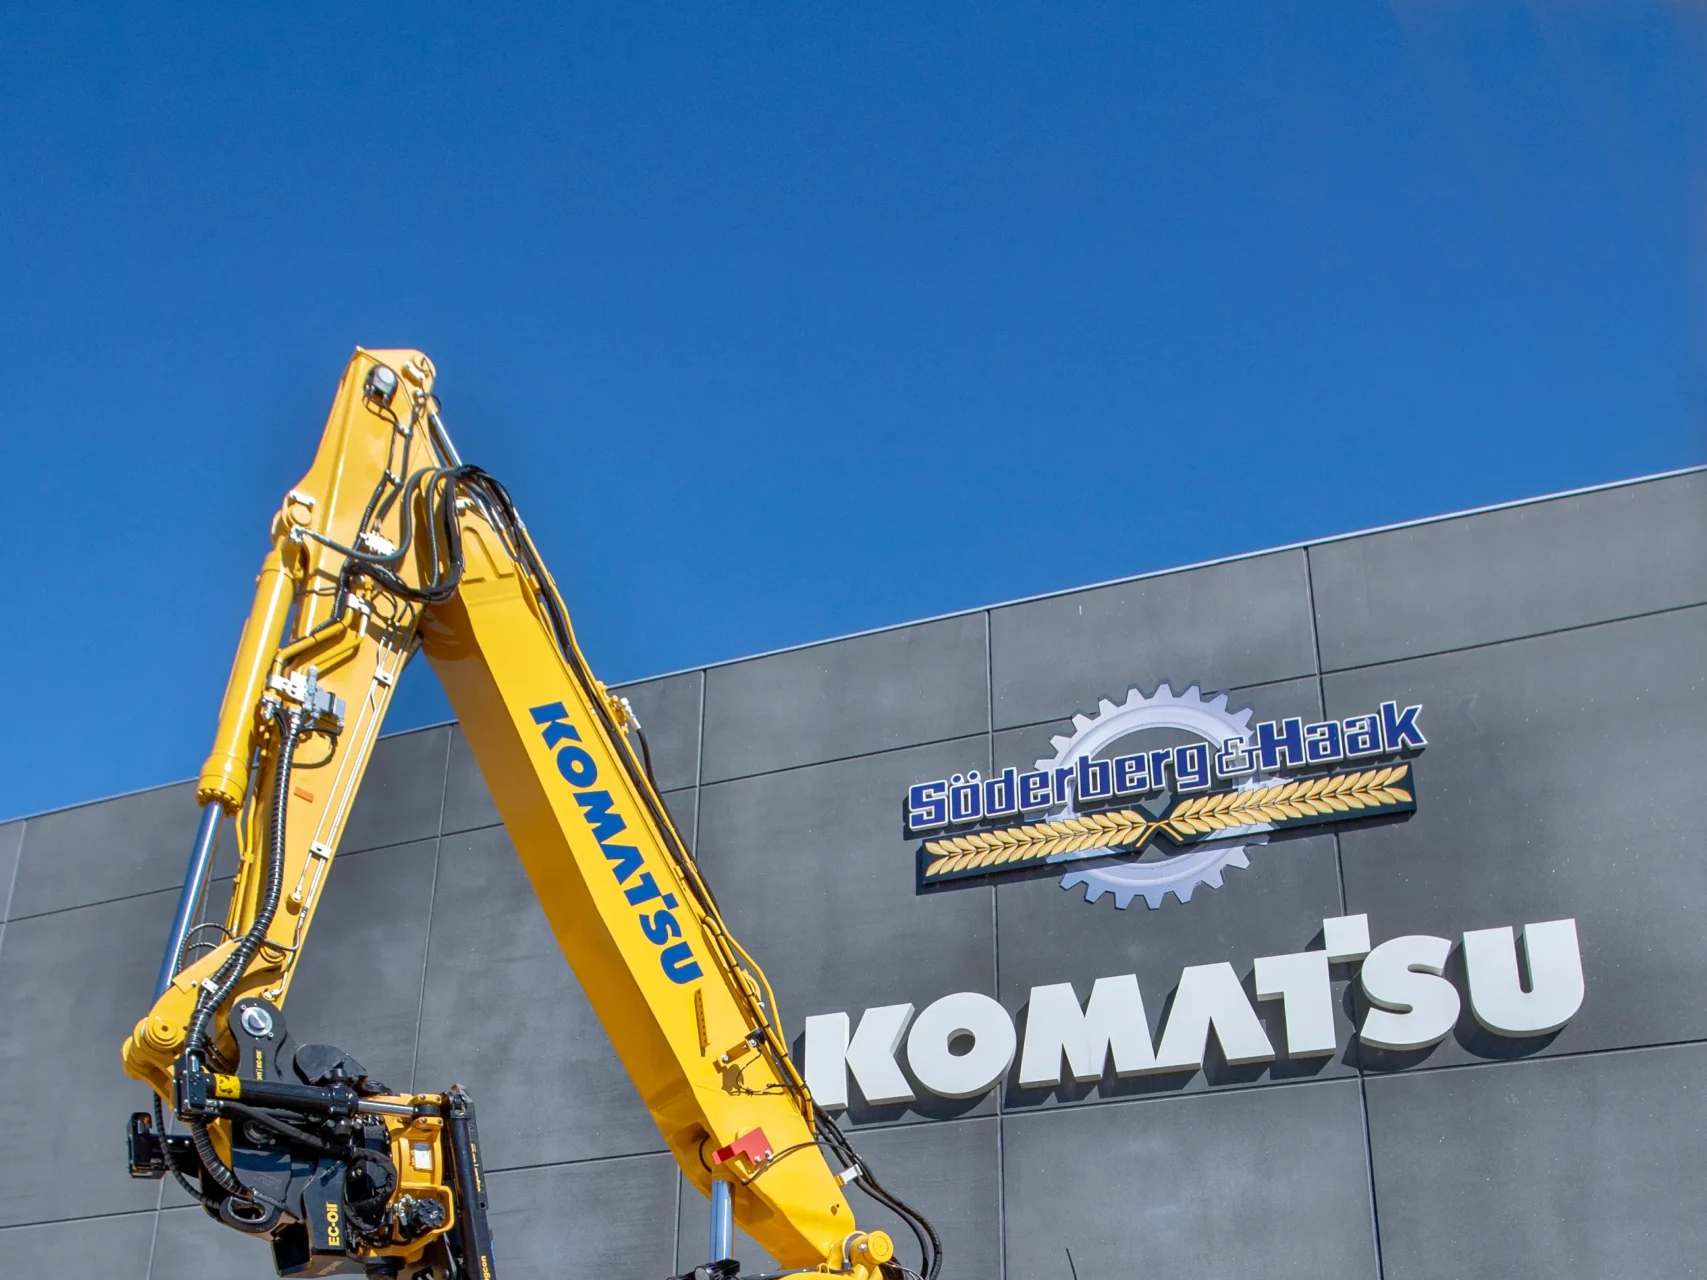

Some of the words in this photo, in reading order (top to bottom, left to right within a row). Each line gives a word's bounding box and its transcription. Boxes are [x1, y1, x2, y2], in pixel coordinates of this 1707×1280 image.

[528, 701, 704, 985] KOMATSU
[908, 742, 1212, 831] Söderberg
[804, 913, 1585, 1110] KOMATSU
[326, 1201, 340, 1246] EC-Oil
